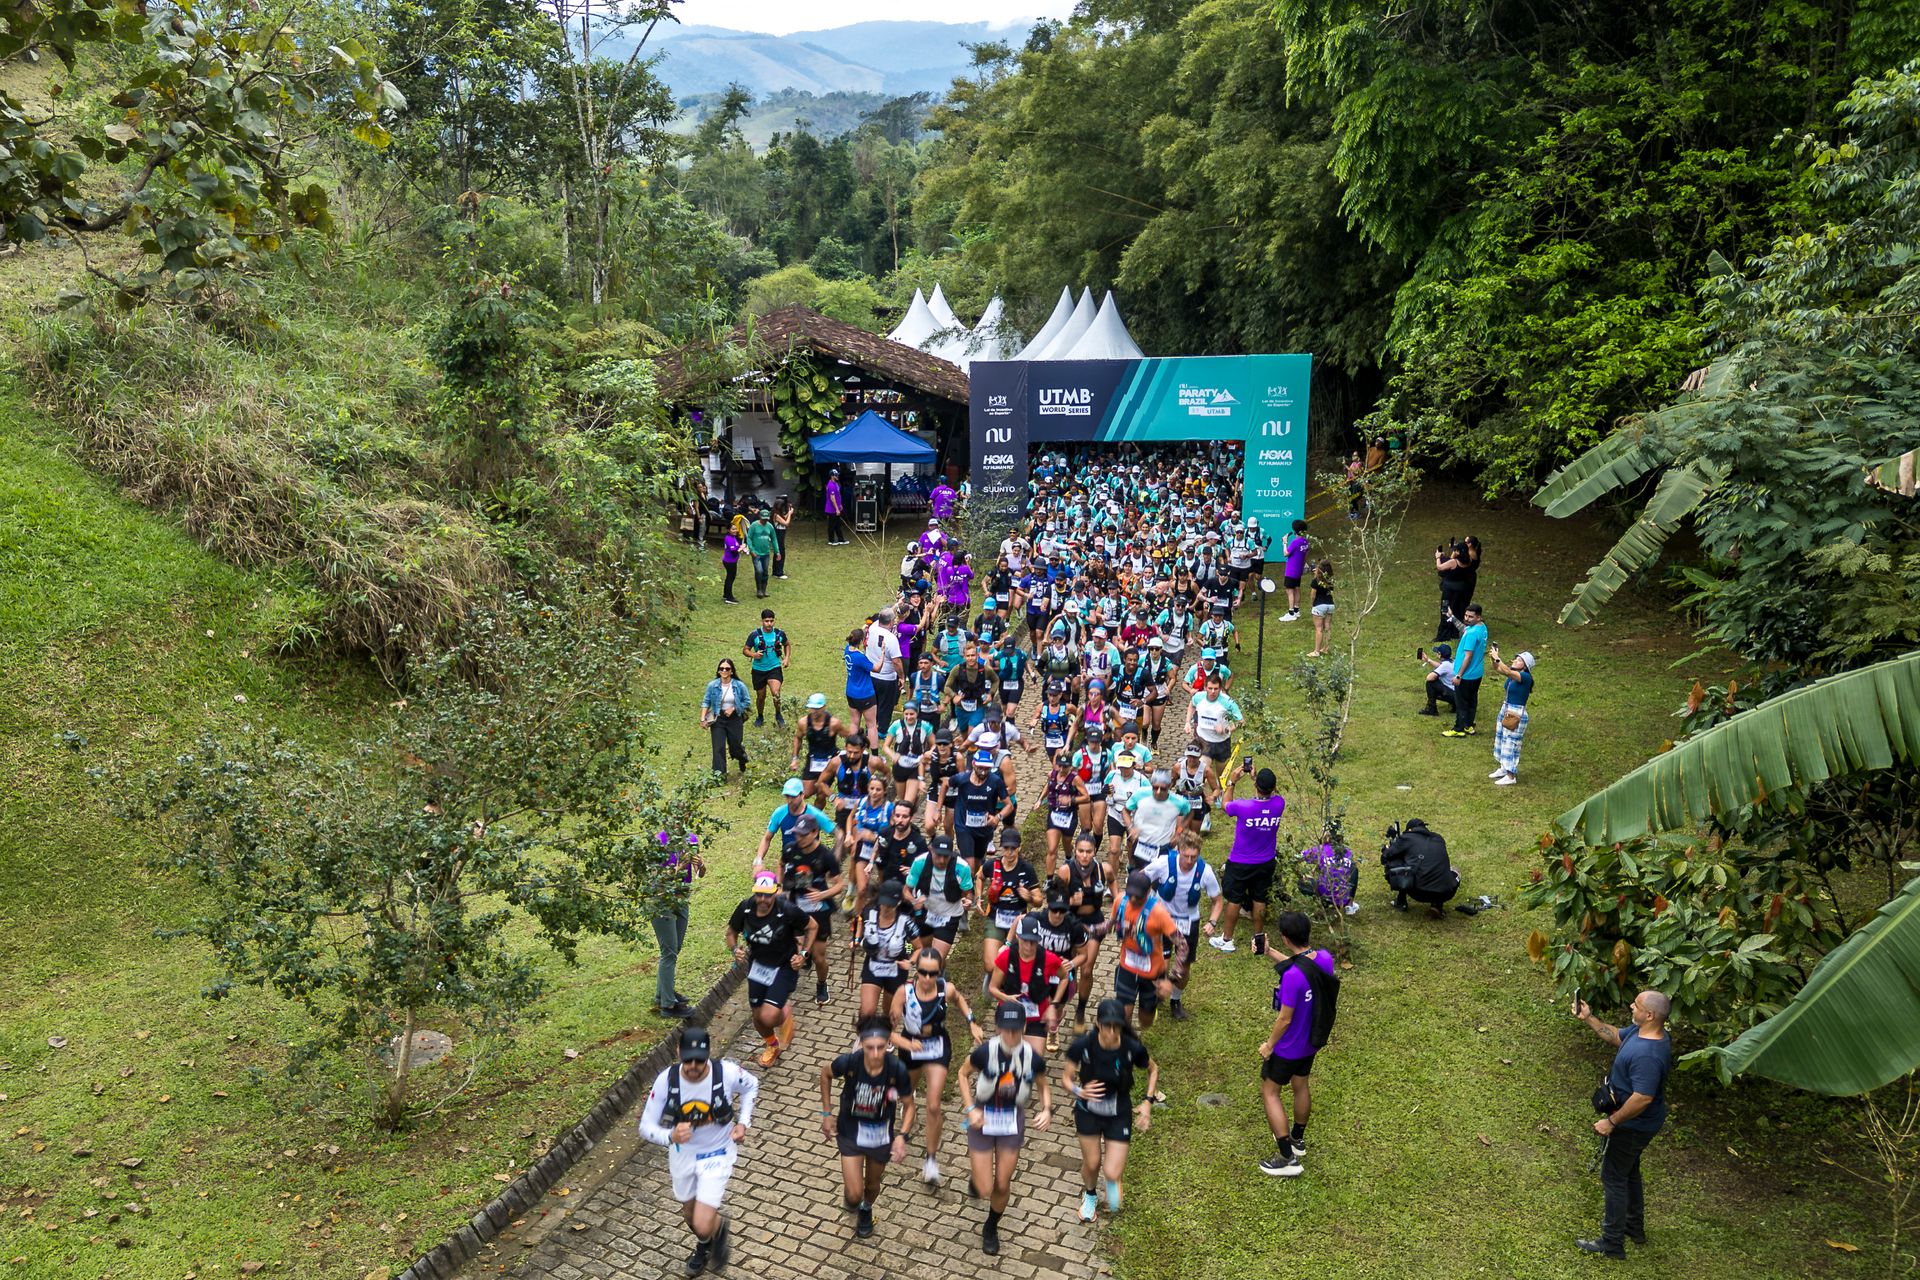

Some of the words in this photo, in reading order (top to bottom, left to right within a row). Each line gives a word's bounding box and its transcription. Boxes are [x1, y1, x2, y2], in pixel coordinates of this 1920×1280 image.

[1179, 388, 1218, 398] PARATY
[983, 454, 1014, 464] HOKA
[1259, 450, 1292, 460] HOKA
[1246, 817, 1280, 827] STAFF
